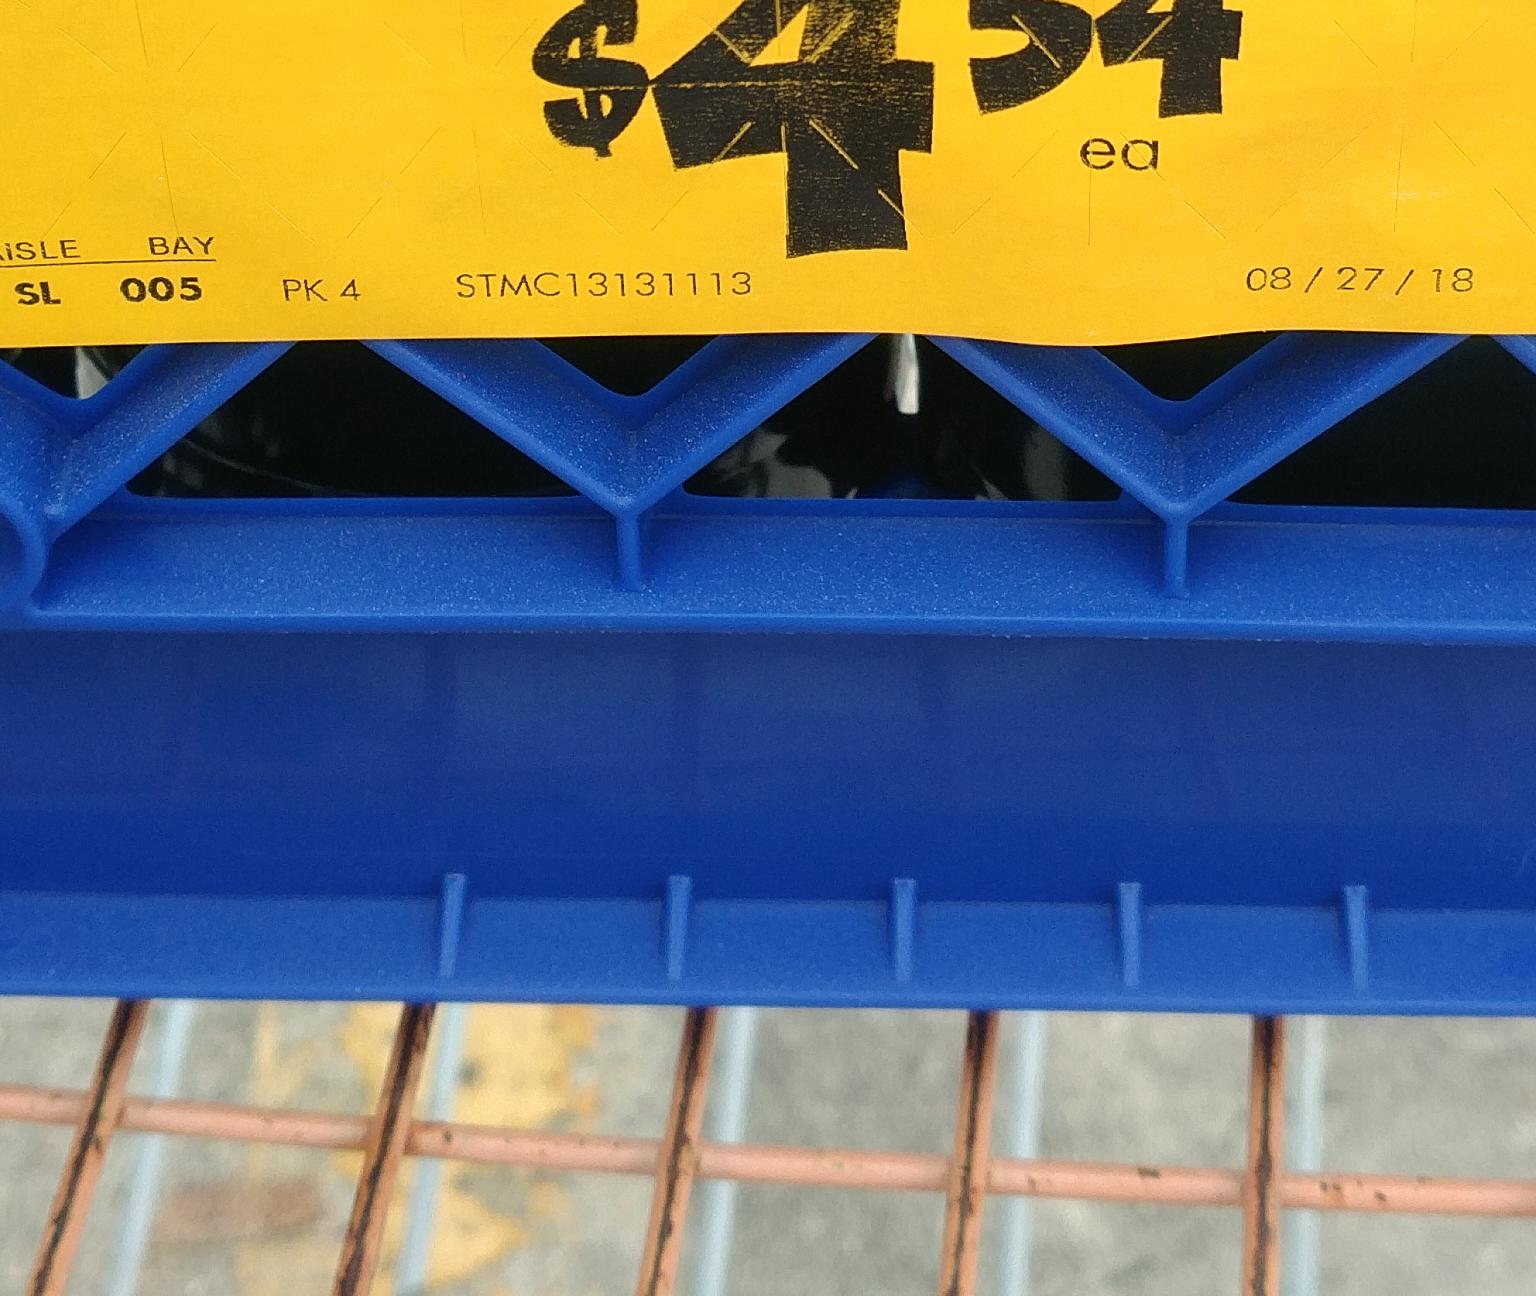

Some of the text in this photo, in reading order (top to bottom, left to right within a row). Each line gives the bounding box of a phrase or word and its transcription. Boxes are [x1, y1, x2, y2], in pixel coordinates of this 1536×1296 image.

[1079, 136, 1161, 172] ea
[148, 236, 215, 256] BAY
[14, 270, 753, 305] SL 005 PK 4 STMC13131113
